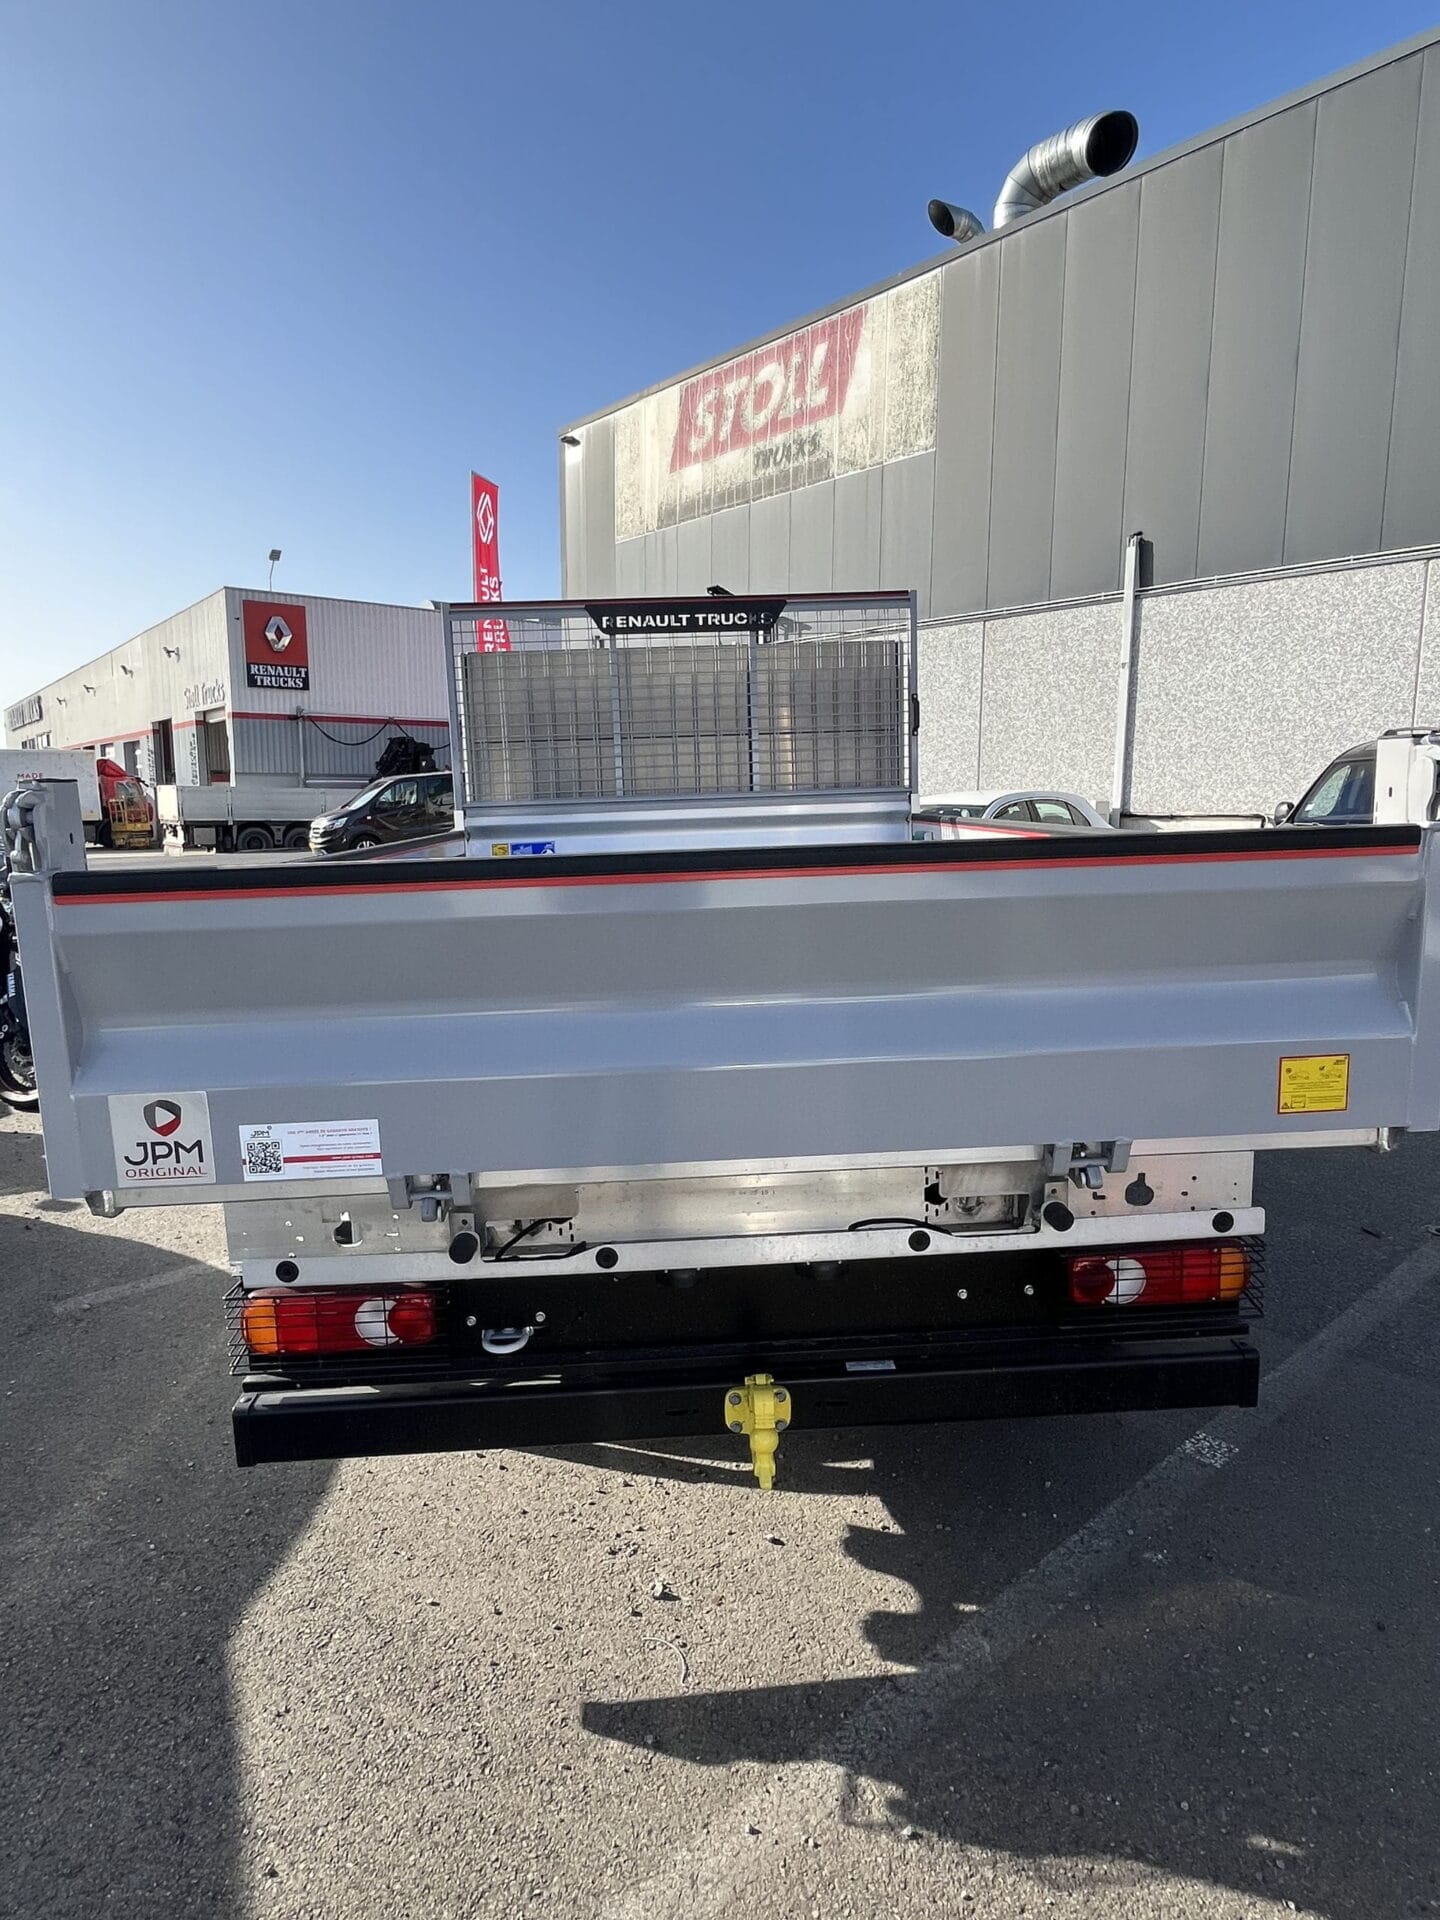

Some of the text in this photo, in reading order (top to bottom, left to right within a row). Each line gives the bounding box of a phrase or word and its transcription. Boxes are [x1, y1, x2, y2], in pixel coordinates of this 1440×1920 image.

[688, 341, 829, 452] STOLL
[602, 613, 691, 629] RENAULT
[250, 663, 307, 678] RENAULT
[254, 675, 304, 689] TRUCKS
[124, 1140, 204, 1166] JPM
[125, 1166, 208, 1178] ORIGINAL
